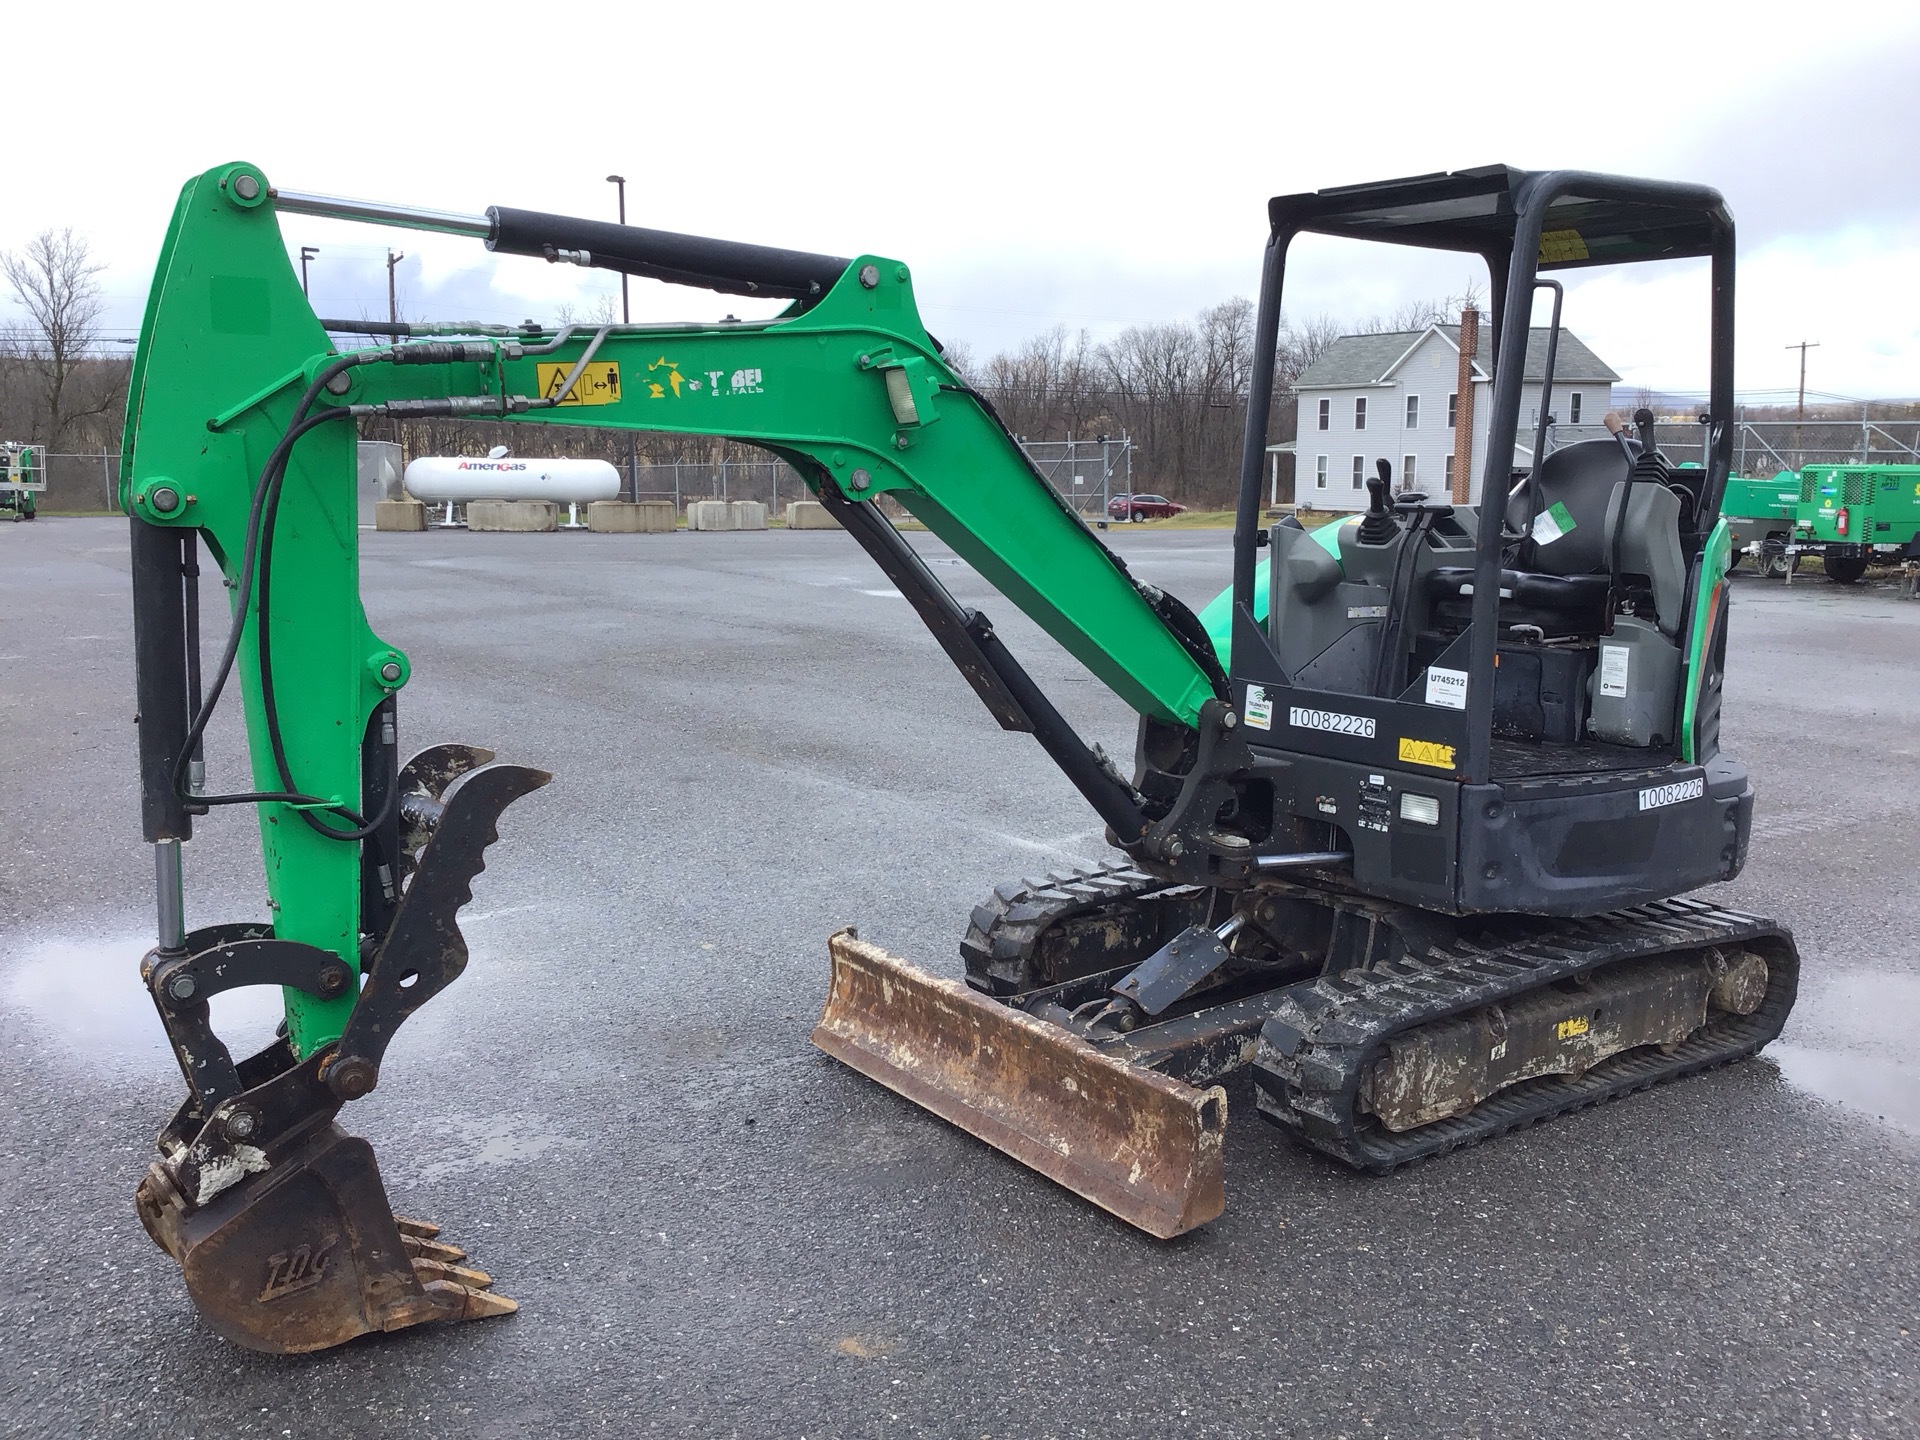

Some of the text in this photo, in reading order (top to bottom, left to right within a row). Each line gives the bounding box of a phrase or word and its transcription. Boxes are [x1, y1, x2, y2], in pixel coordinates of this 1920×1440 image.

[458, 462, 527, 472] AmeriGas
[1430, 674, 1465, 687] U745212
[1292, 708, 1374, 737] 10082226
[1641, 779, 1702, 808] 10082226
